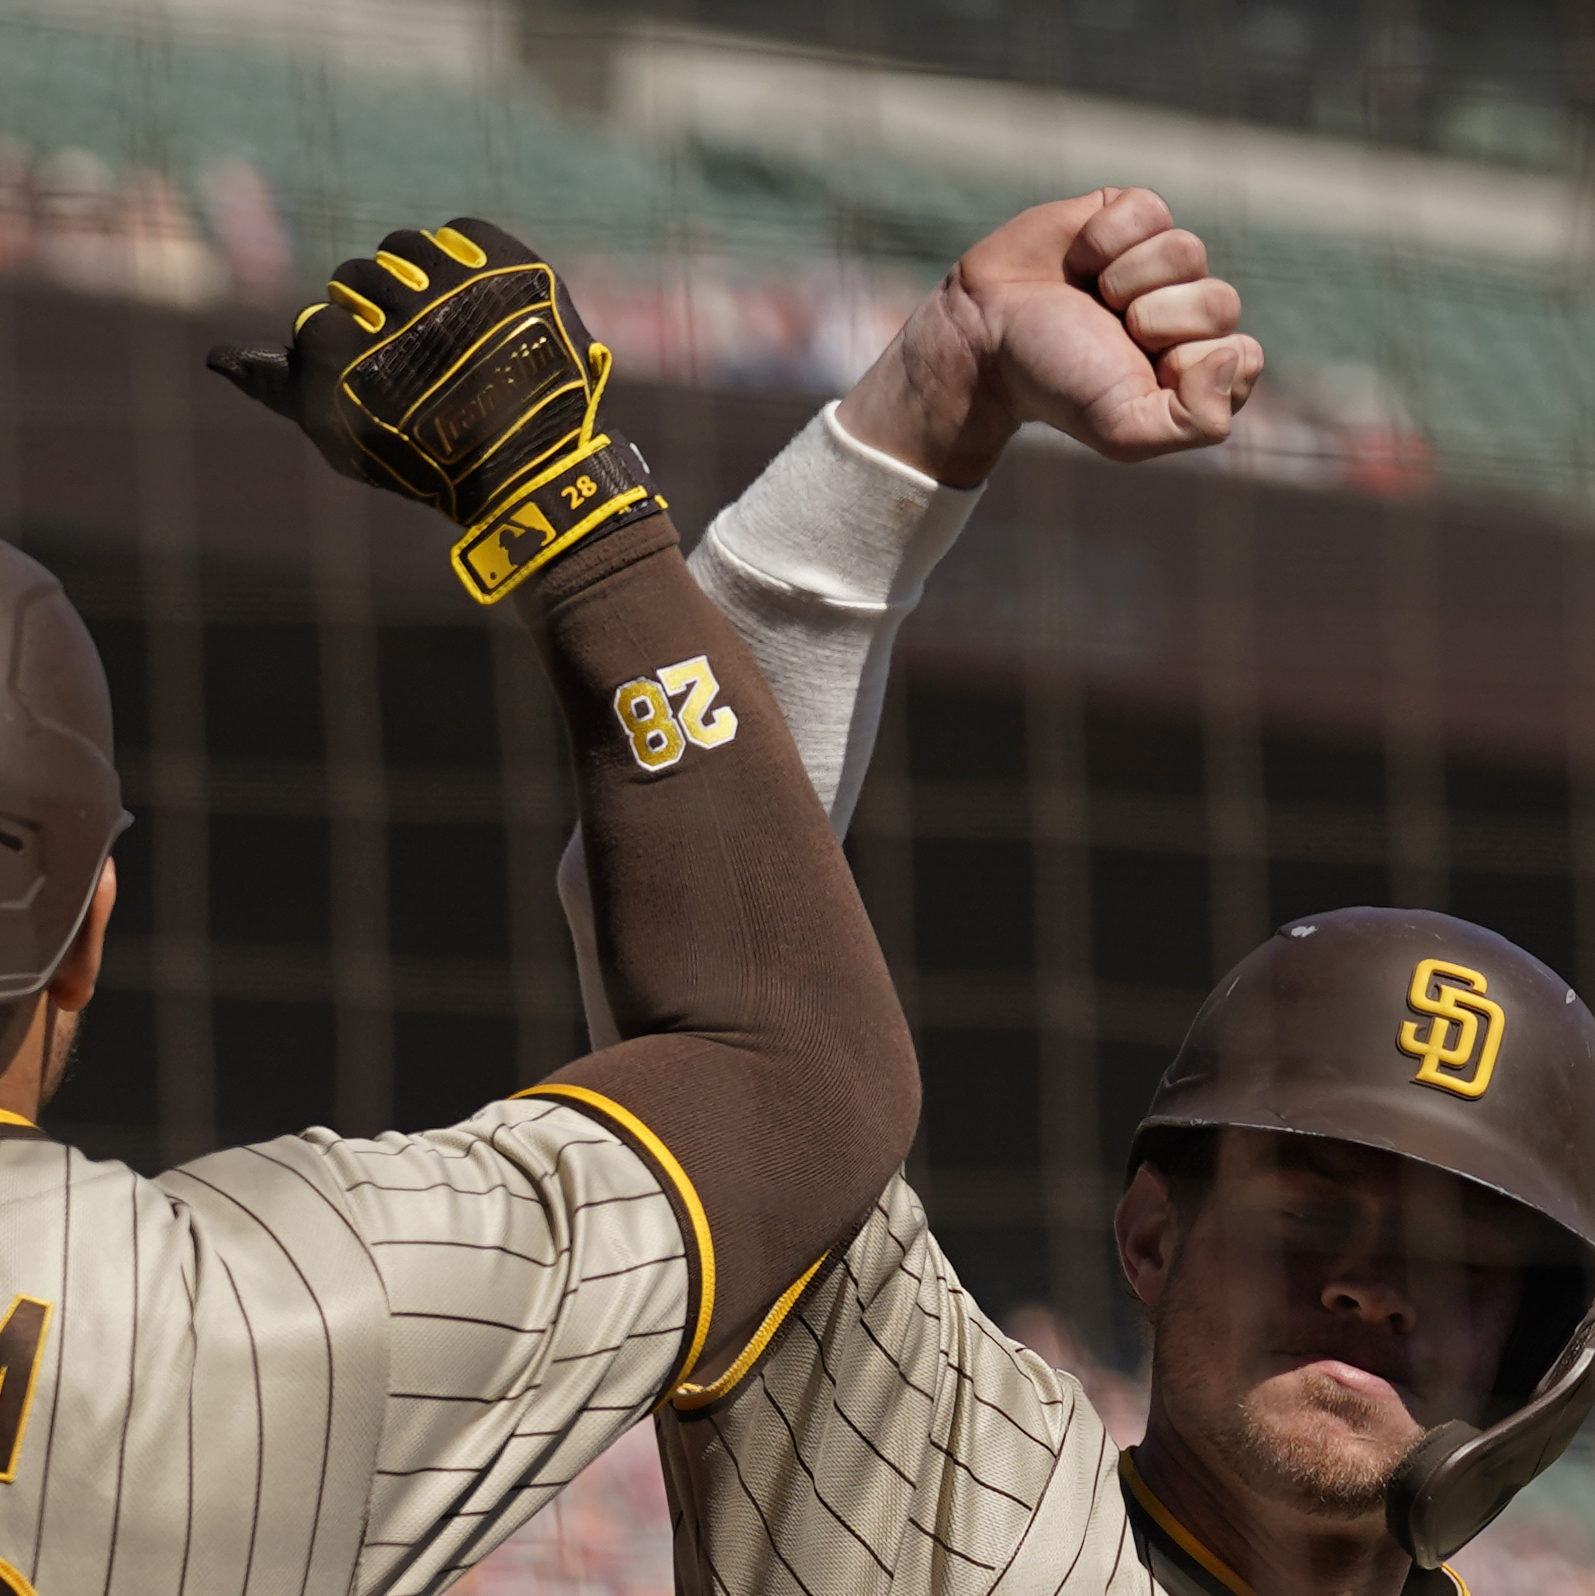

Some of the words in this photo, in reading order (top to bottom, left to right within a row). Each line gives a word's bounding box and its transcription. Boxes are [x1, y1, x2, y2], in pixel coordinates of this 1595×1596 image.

[561, 474, 598, 510] 28
[613, 655, 738, 773] 28
[1398, 958, 1506, 1098] SD
